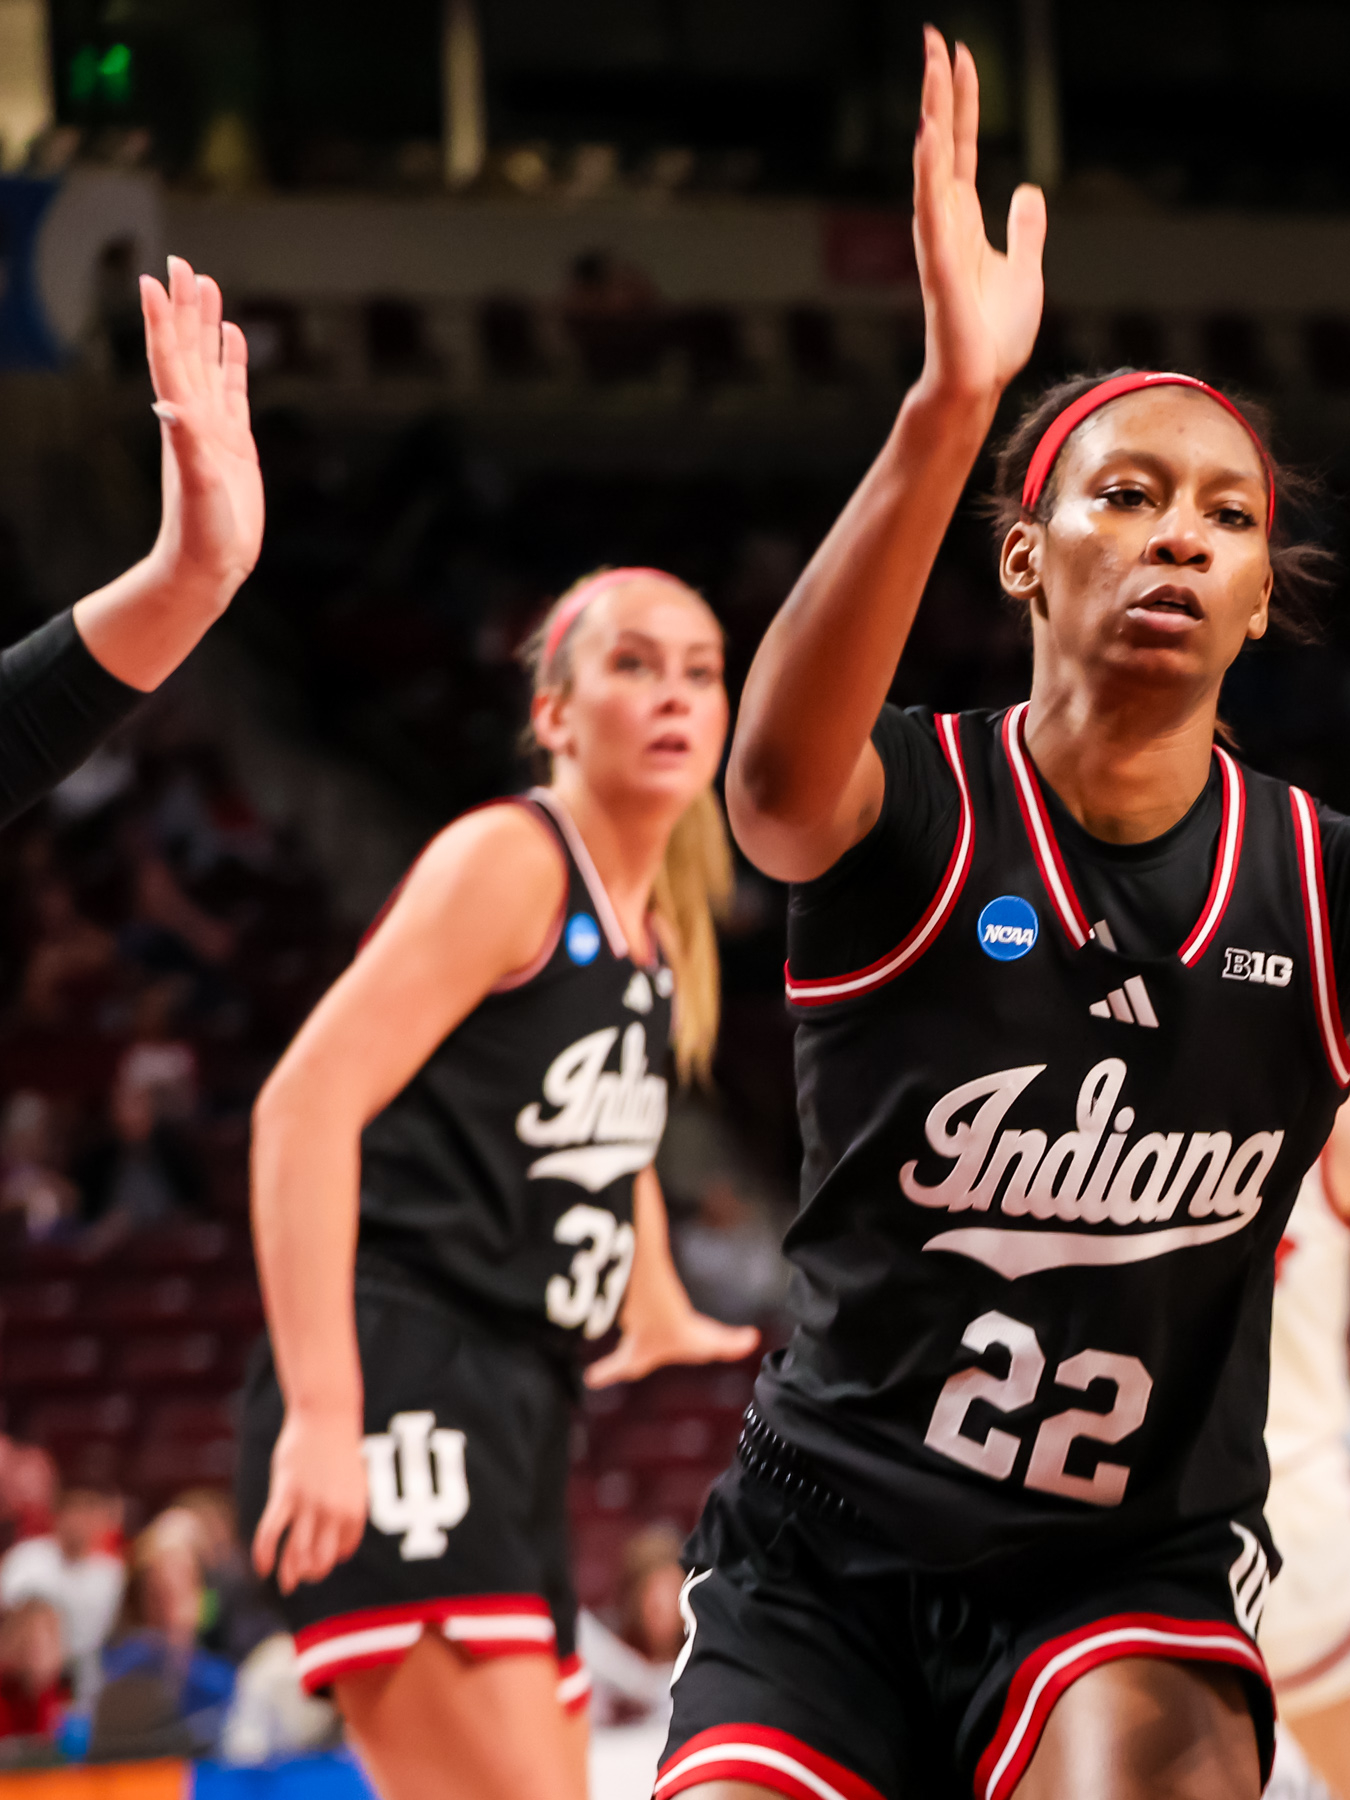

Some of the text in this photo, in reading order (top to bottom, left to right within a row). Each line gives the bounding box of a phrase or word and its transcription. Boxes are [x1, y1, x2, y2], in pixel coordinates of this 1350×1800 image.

[982, 923, 1034, 948] NCAA
[898, 1057, 1286, 1226] Indiana
[545, 1203, 635, 1340] 33
[923, 1308, 1154, 1508] 22
